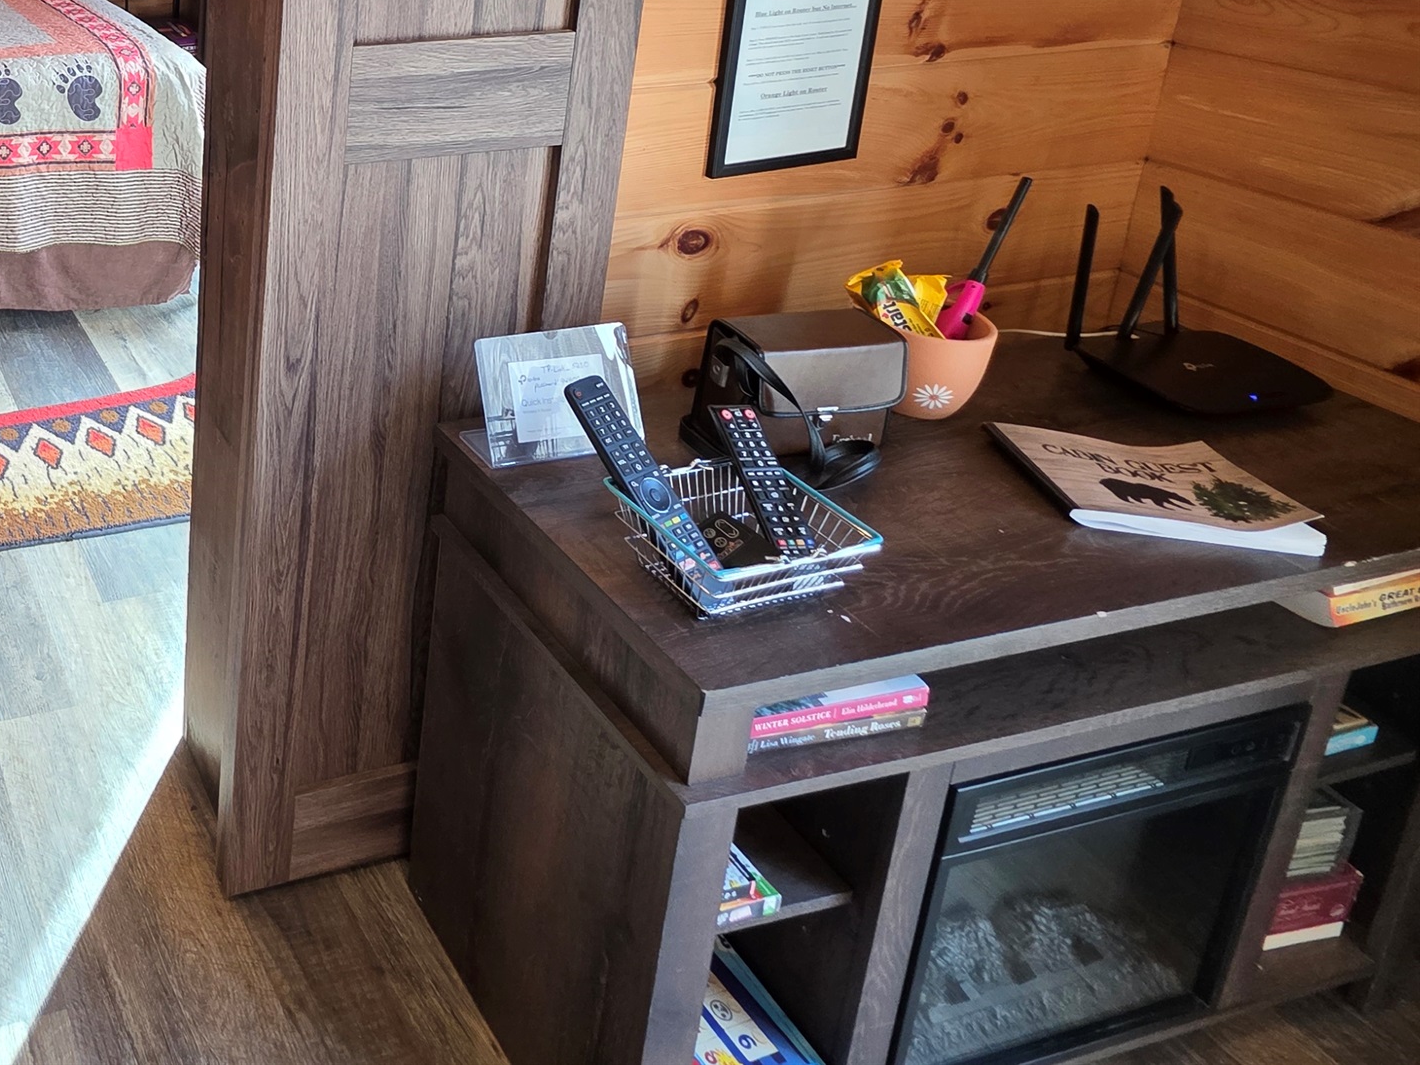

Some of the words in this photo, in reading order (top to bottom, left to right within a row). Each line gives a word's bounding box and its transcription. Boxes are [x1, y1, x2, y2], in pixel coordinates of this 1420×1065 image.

[1095, 462, 1173, 484] BOOK
[1124, 459, 1216, 474] GUEST
[1379, 587, 1416, 602] GREAT
[754, 718, 789, 732] WINTER
[790, 710, 832, 725] SOLSTICE
[841, 706, 856, 716] Elin
[760, 739, 778, 749] Lisa
[824, 724, 869, 739] Tending
[869, 720, 901, 733] Roses
